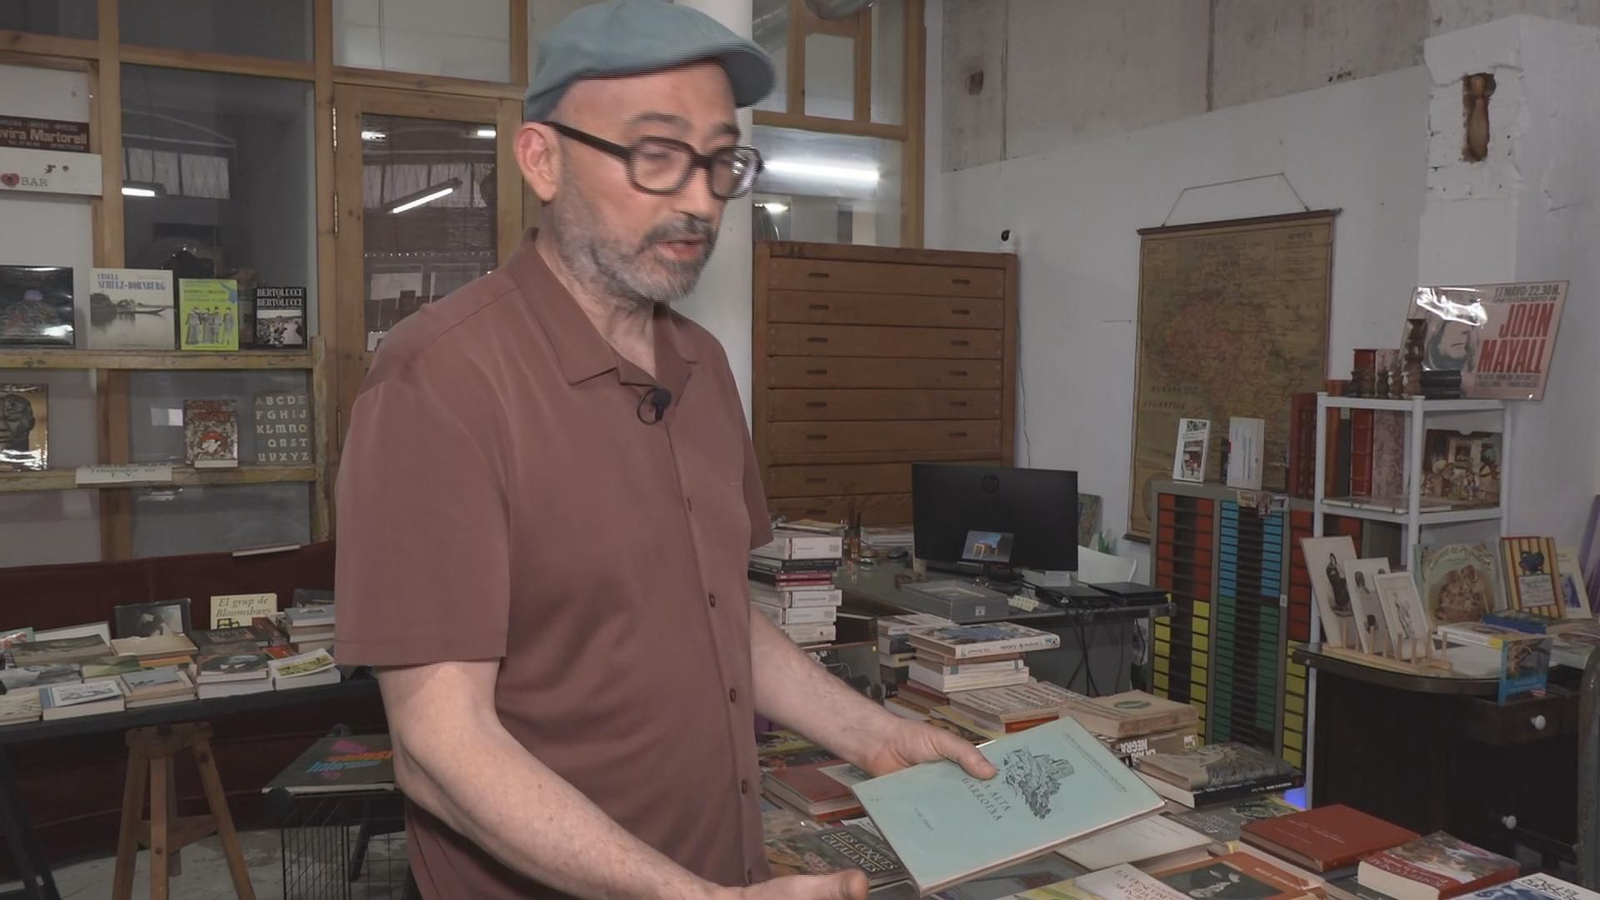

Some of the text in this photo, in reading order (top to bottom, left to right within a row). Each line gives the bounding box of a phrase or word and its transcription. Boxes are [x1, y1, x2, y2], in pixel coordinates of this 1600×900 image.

[30, 128, 88, 144] Martorell
[21, 177, 48, 187] BAR
[256, 288, 302, 297] BERTOLUCCI
[256, 298, 302, 306] BERTOLUCCI
[1498, 303, 1555, 338] JOHN
[1477, 339, 1547, 373] MAYALL
[218, 596, 269, 608] El grup de
[1119, 738, 1148, 754] NEGRA
[961, 777, 1004, 822] GARROTXA
[990, 790, 1012, 813] ALTA
[836, 831, 859, 844] LES
[821, 834, 882, 874] CATALANES
